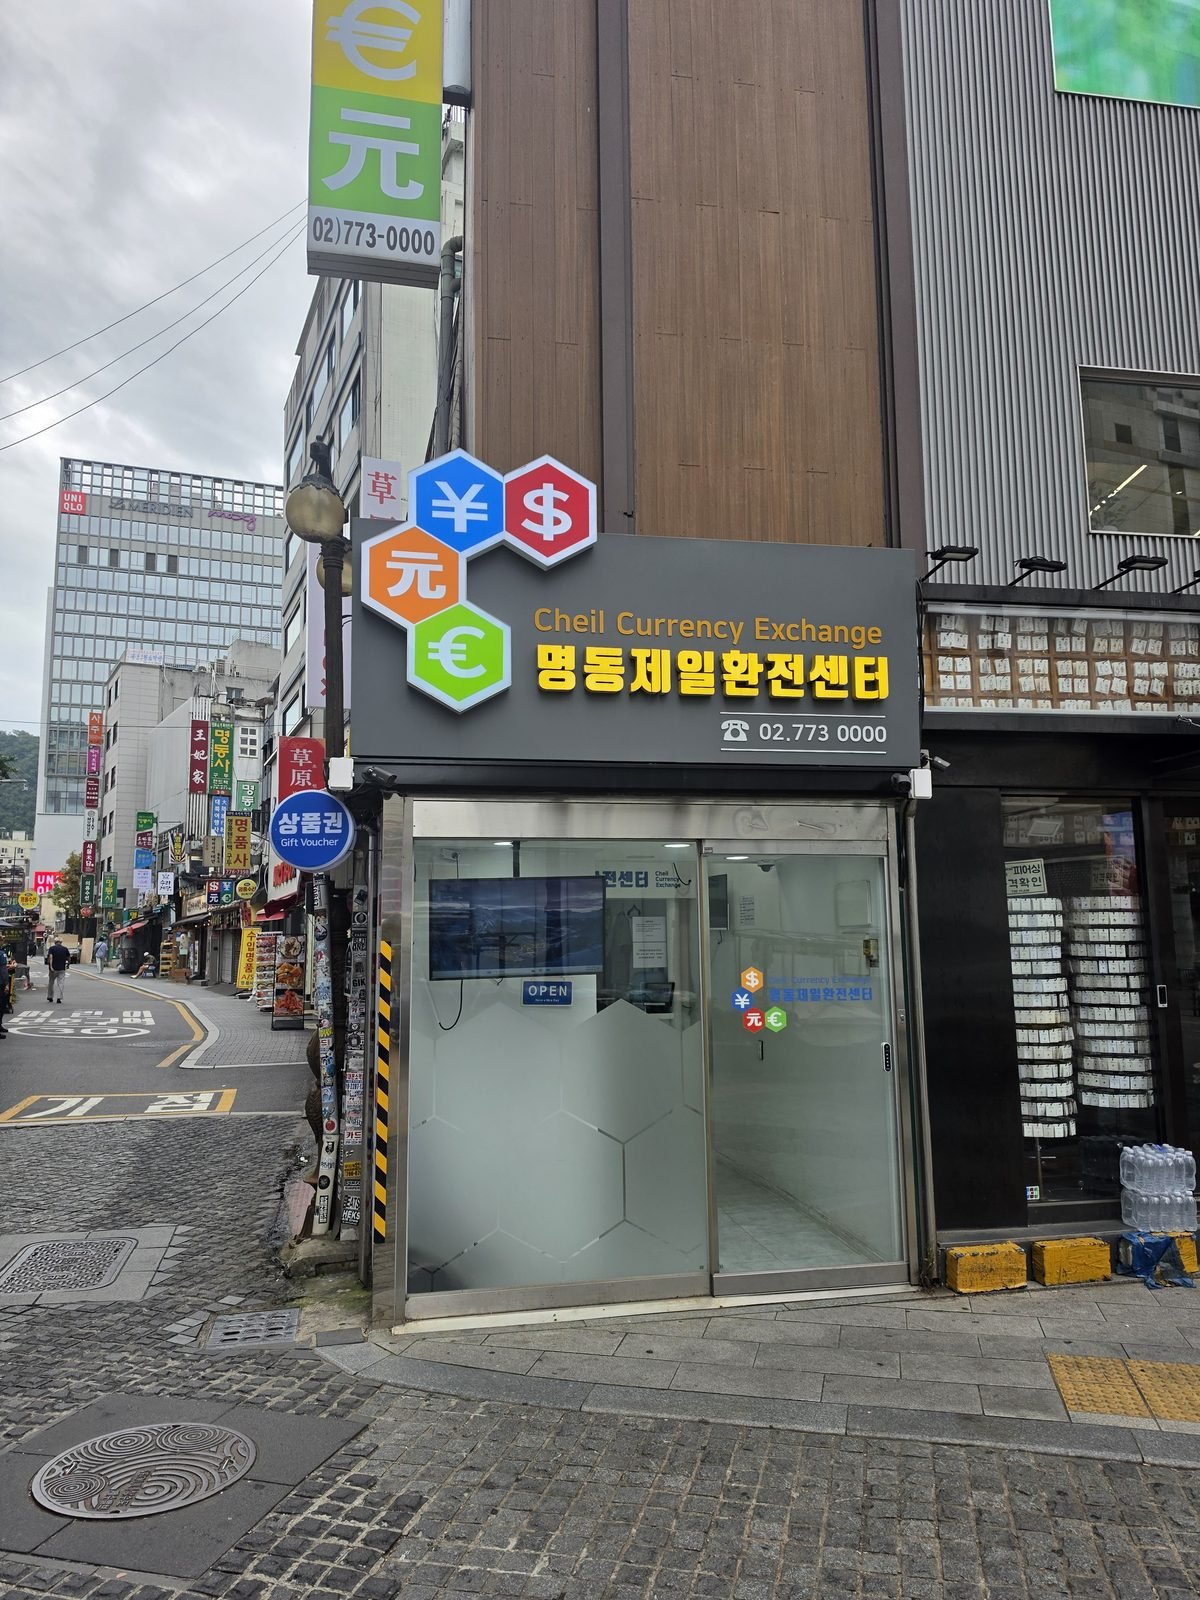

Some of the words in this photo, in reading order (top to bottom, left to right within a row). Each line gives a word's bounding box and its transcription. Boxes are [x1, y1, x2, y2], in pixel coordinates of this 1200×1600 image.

[321, 107, 424, 200] 元
[312, 216, 436, 256] 02)773-0000
[63, 493, 82, 502] UNI
[63, 502, 83, 512] QLO
[386, 550, 447, 599] 元
[534, 607, 605, 634] Cheil
[616, 611, 745, 645] Currency
[754, 617, 882, 650] Exchange
[537, 643, 889, 700] 명동제일환전센터
[758, 722, 830, 744] 02.773
[836, 724, 887, 744] 0000
[191, 729, 208, 784] 王妃家
[213, 729, 230, 773] 명동사
[289, 748, 313, 788] 草原
[278, 812, 343, 835] 상품권
[233, 818, 249, 867] 명품사
[280, 838, 298, 847] Gift
[301, 838, 339, 847] Voucher
[1013, 864, 1041, 875] 피어싱
[209, 894, 219, 903] 元
[244, 930, 257, 974] 수입명품
[528, 985, 568, 996] OPEN
[38, 1027, 118, 1036] 30
[746, 1013, 763, 1027] 元
